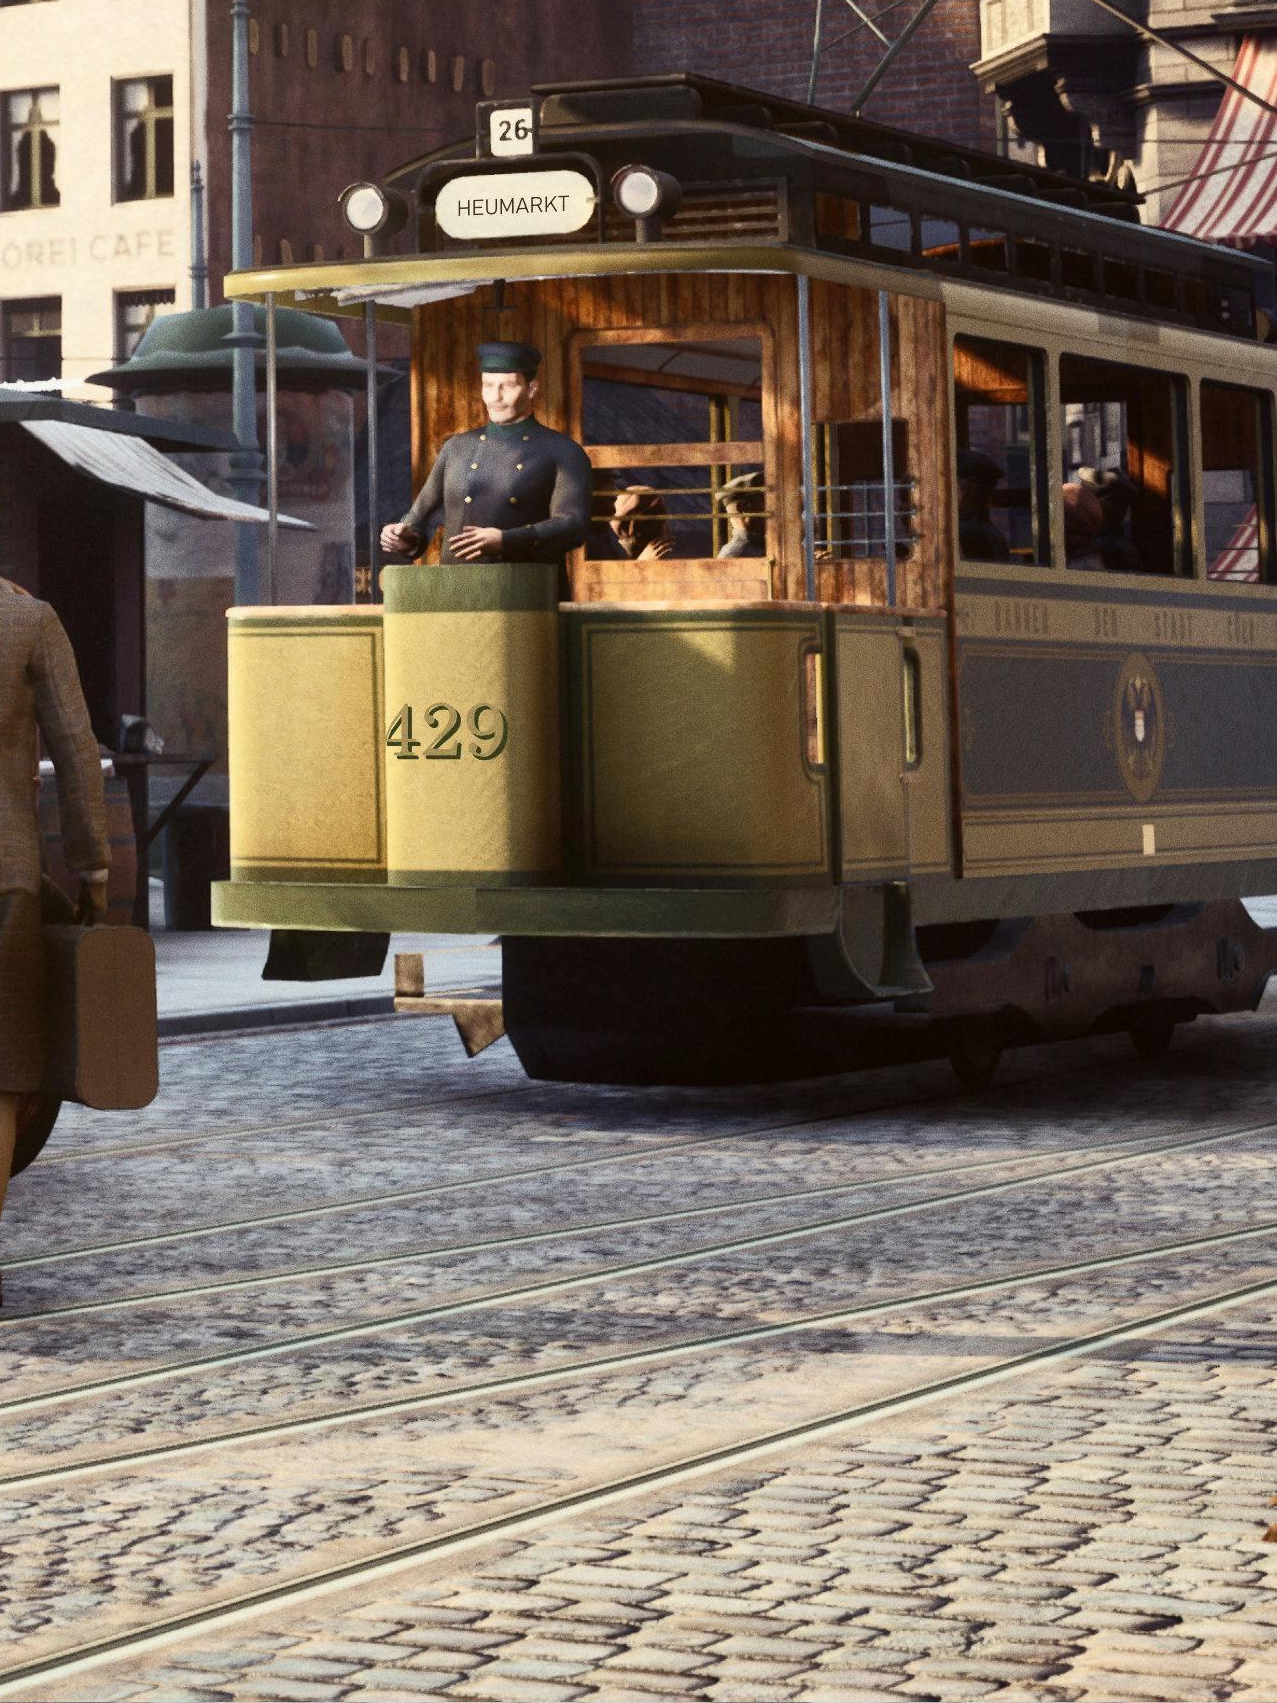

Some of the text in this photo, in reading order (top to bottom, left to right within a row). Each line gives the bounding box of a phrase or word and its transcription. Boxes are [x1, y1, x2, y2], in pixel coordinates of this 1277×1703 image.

[498, 118, 529, 142] 26
[457, 194, 570, 217] HEUMARKT
[385, 702, 510, 761] 429
